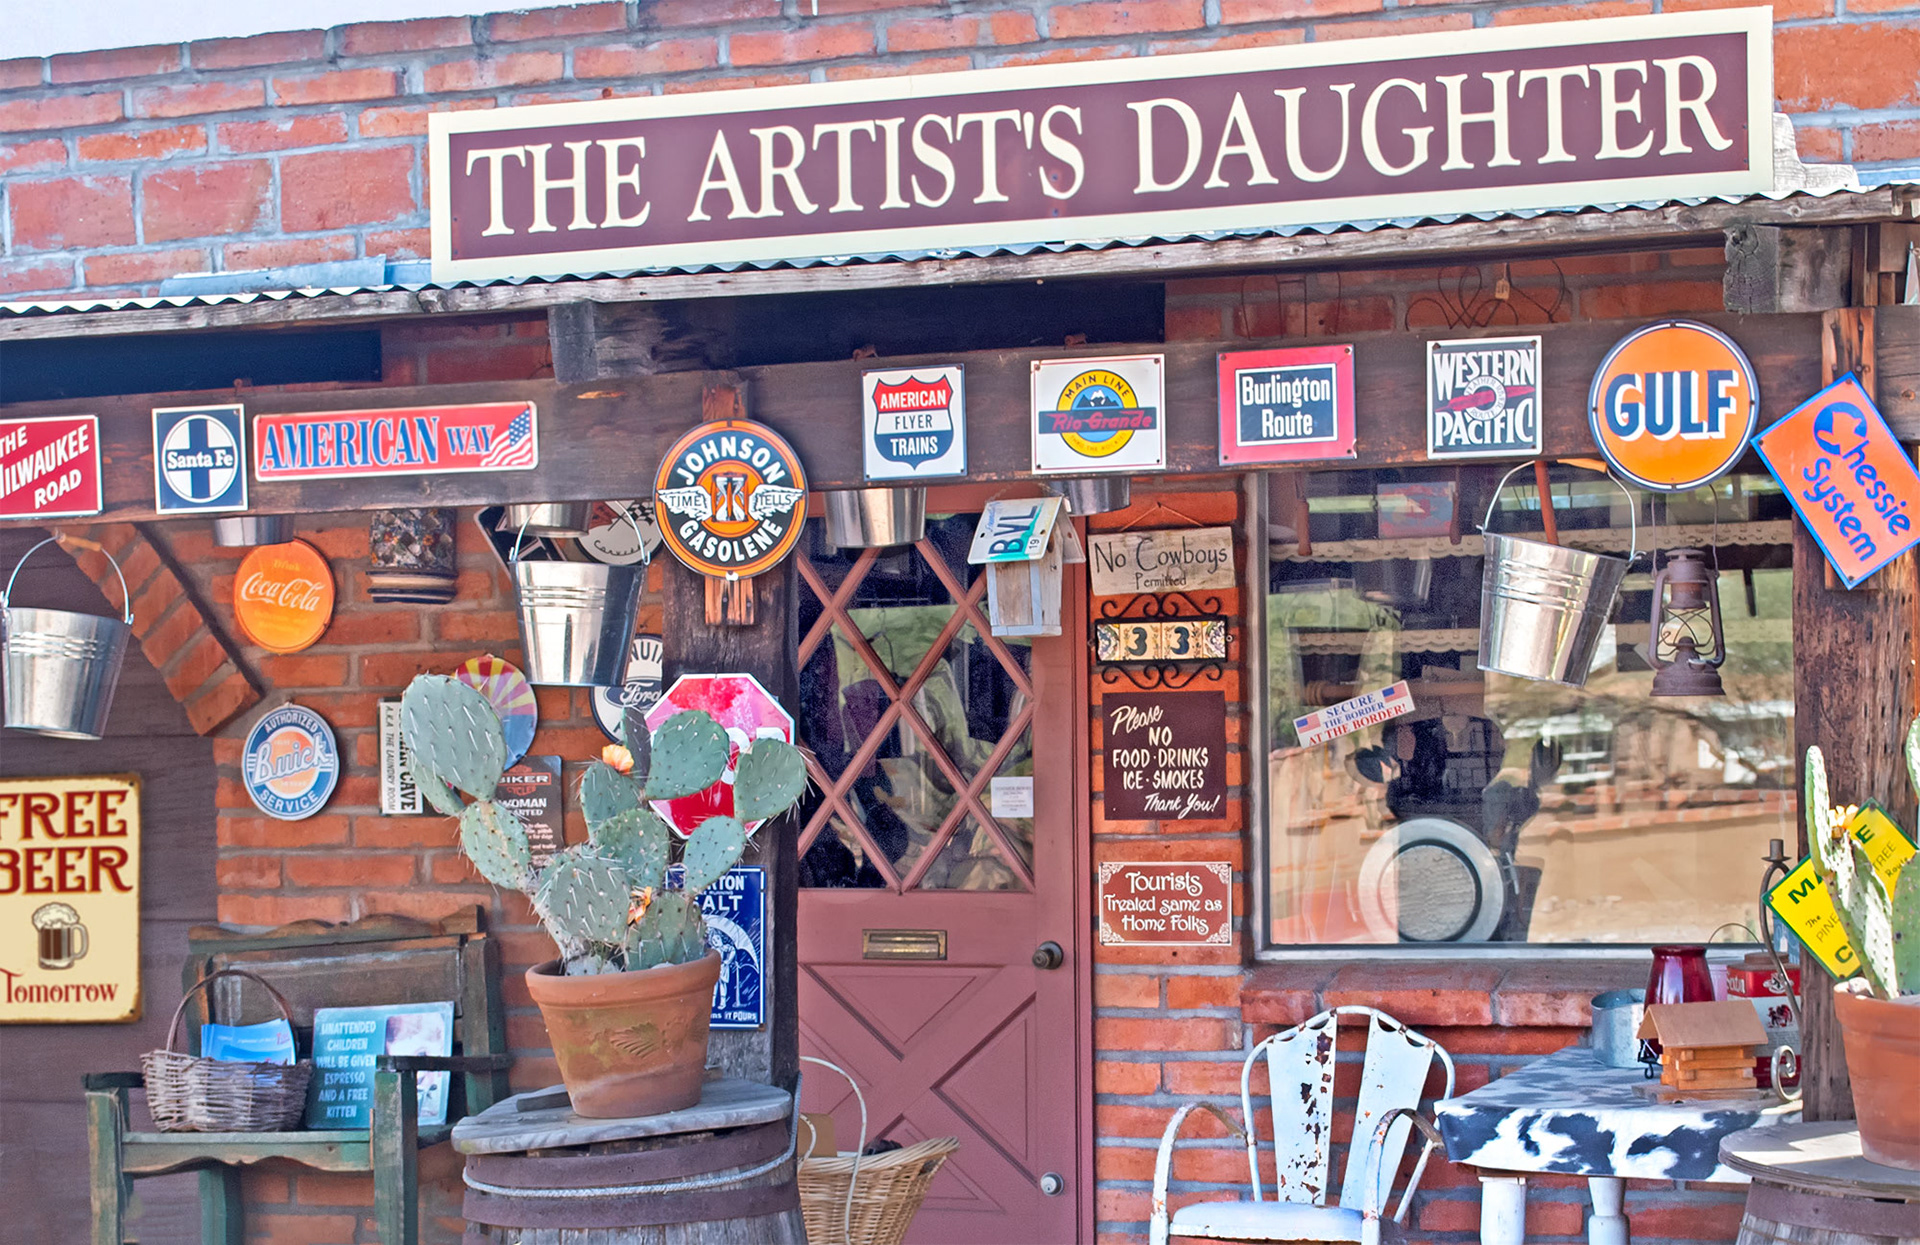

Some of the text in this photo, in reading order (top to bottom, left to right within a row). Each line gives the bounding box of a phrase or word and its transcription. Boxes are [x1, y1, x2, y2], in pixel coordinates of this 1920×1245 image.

[465, 54, 1734, 238] THE ARTIST'S DAUGHTER
[1065, 374, 1131, 400] MAIN LINE
[1433, 349, 1535, 401] WESTERN
[880, 390, 946, 409] AMERICAN
[1242, 374, 1330, 408] Burlington
[1605, 370, 1739, 442] GULF
[895, 415, 933, 429] FLYER
[1046, 410, 1153, 431] Rio Grande
[1262, 408, 1313, 438] Route
[1435, 398, 1534, 447] PACIFIC
[0, 425, 27, 458] THE
[261, 417, 496, 470] AMERICAN WAY
[890, 437, 938, 456] TRAINS
[0, 424, 89, 499] ILWAUKEE
[167, 449, 234, 469] Santa Fe
[677, 436, 786, 486] JOHNSON
[1813, 402, 1910, 536] Chessie
[34, 468, 82, 509] ROAD
[669, 494, 792, 507] TIME TELLS
[1803, 457, 1877, 562] System
[680, 518, 783, 562] GASOLENE
[1094, 536, 1228, 574] No Cowboys
[241, 571, 325, 612] Coca-Cola
[1135, 571, 1187, 590] Permitted
[1324, 702, 1386, 729] THE BORDER
[1326, 693, 1376, 718] SECURE
[264, 713, 319, 733] AUTHORIZED
[1110, 705, 1163, 735] Please
[1309, 703, 1407, 746] AT THE BORDER!
[386, 732, 395, 747] THE
[1149, 726, 1173, 747] NO
[253, 732, 332, 786] Buick
[385, 750, 395, 785] LAUNDRY
[1113, 747, 1208, 768] FOOD DRINKS
[399, 771, 416, 810] CAVE
[1123, 769, 1205, 790] ICE SMOKES
[260, 789, 319, 812] SERVICE
[386, 786, 396, 811] ROOM
[1144, 793, 1221, 819] Thank You!
[0, 789, 129, 841] FREE
[1872, 841, 1897, 871] TREE
[0, 846, 134, 896] BEER
[1125, 871, 1203, 897] Tourists
[1103, 894, 1222, 915] Treated same as
[1121, 914, 1209, 936] Home Folks
[1805, 914, 1822, 928] The
[1816, 912, 1842, 943] PINE
[0, 967, 119, 1004] Tomorrow
[321, 1021, 376, 1036] UNATTENDED
[326, 1038, 368, 1051] CHILDREN
[316, 1054, 376, 1068] WILL BE GIVEN
[324, 1071, 366, 1085] ESPRESSO
[318, 1088, 368, 1102] AND A FREE
[326, 1105, 357, 1118] KITTEN
